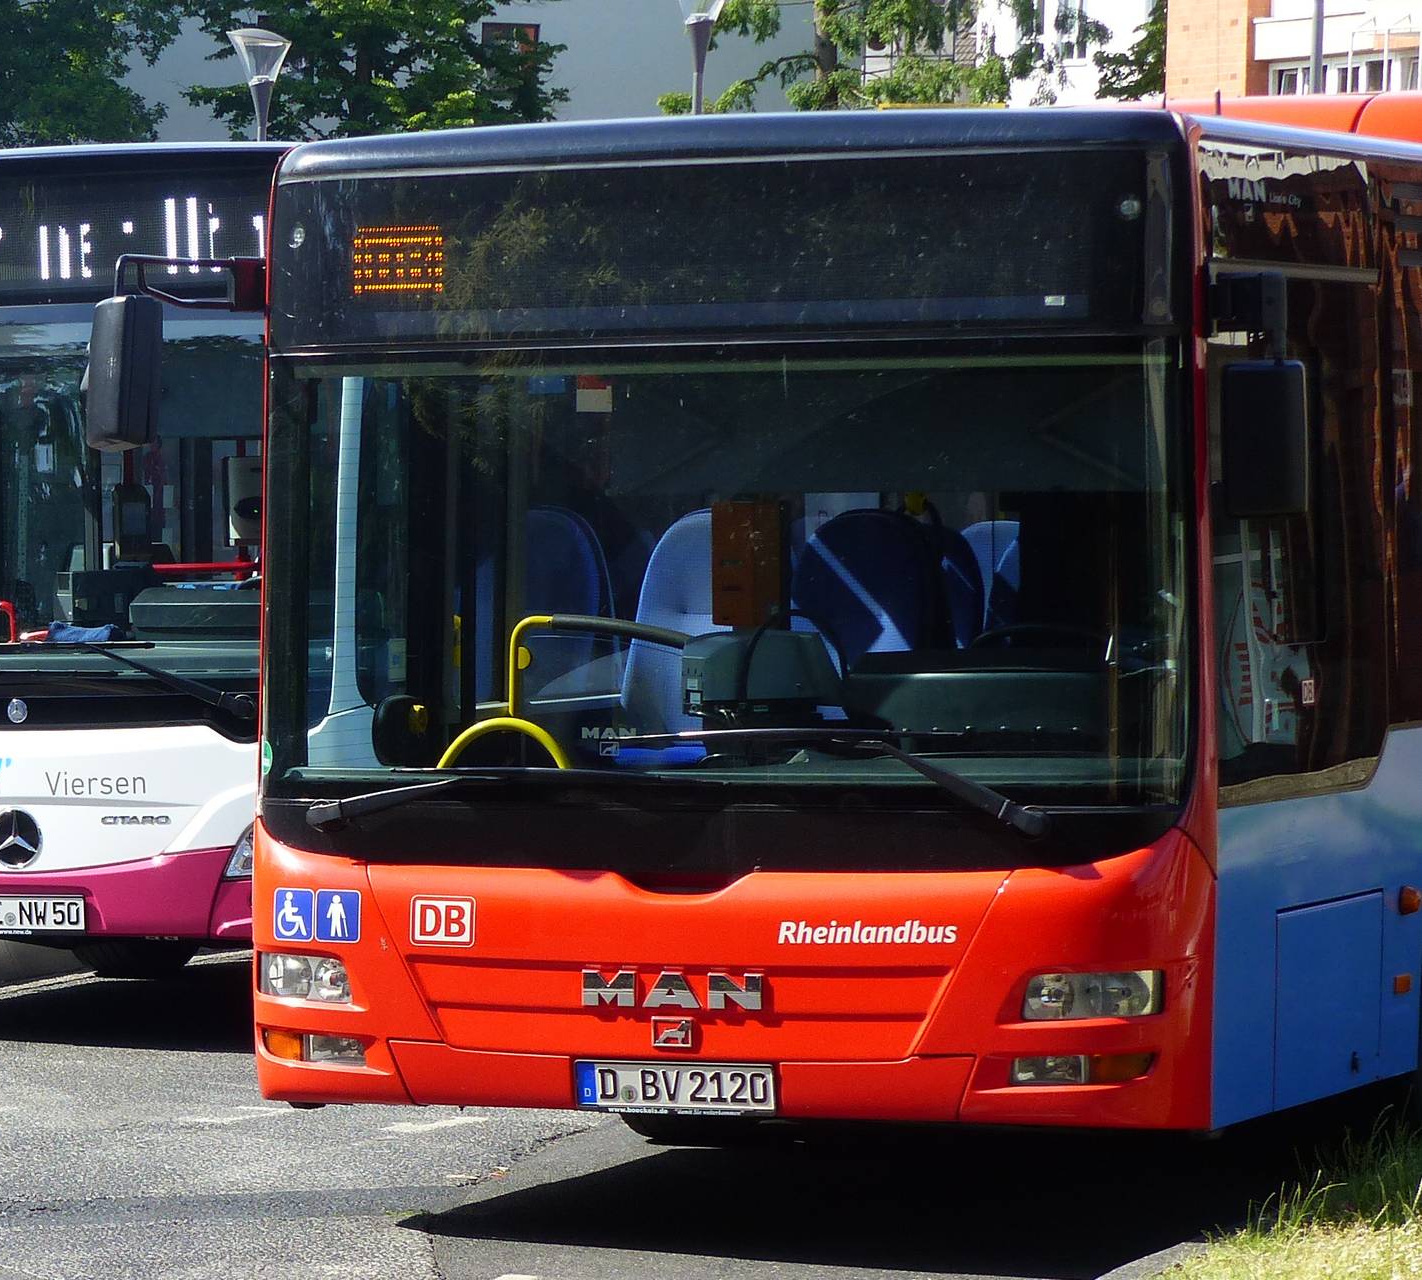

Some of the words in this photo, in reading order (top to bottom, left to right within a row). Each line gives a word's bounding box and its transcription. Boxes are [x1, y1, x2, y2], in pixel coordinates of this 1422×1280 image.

[581, 727, 637, 739] MAN
[45, 771, 147, 796] Viersen
[101, 815, 171, 826] CITARO
[18, 901, 47, 926] NW
[52, 902, 80, 926] 50
[419, 904, 467, 937] DB
[778, 920, 957, 946] Rheinlandbus
[581, 968, 765, 1011] MAN
[598, 1068, 618, 1100] D
[641, 1069, 680, 1101] BV
[689, 1071, 768, 1104] 2120
